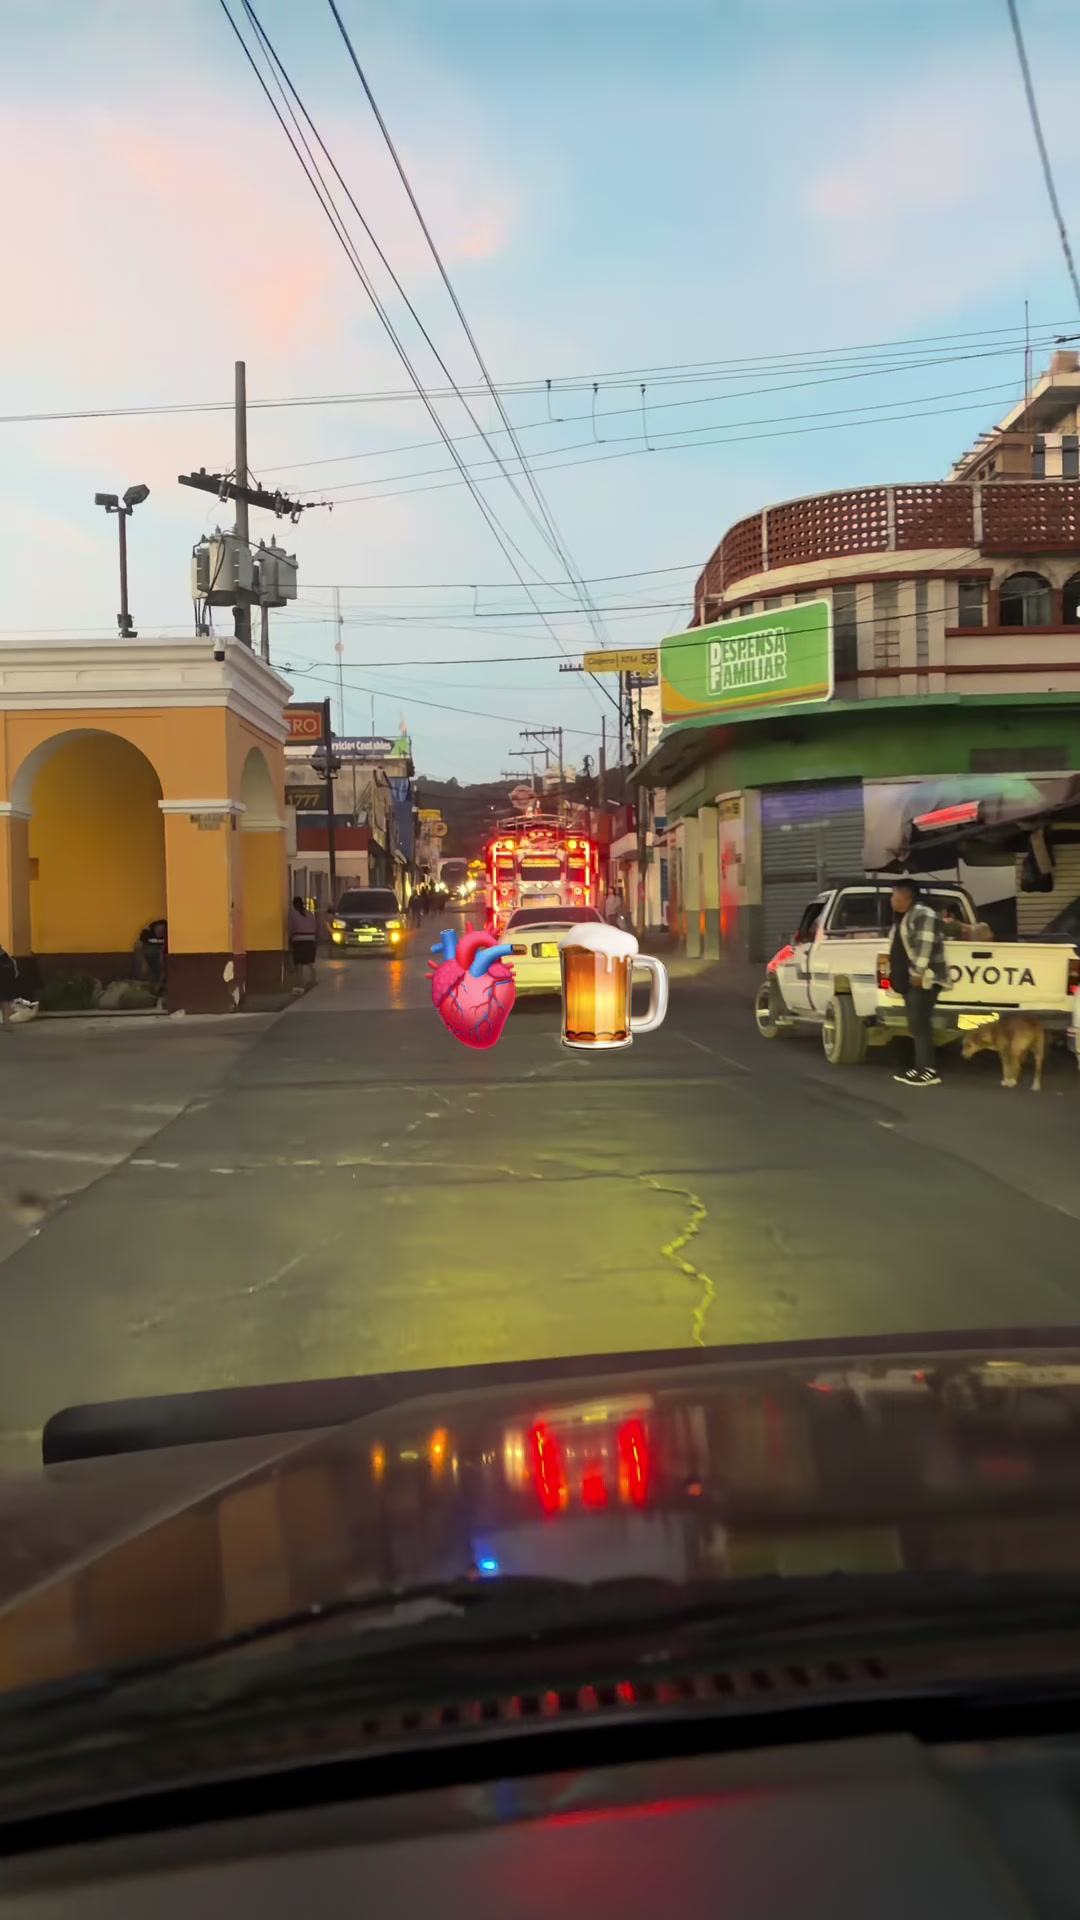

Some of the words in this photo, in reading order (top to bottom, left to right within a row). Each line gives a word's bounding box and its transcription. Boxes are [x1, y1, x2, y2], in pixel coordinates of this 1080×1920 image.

[708, 628, 785, 665] DESPENSA
[709, 653, 785, 690] FAMILIAR
[356, 741, 391, 750] Contables
[948, 964, 1036, 986] OYOTA
